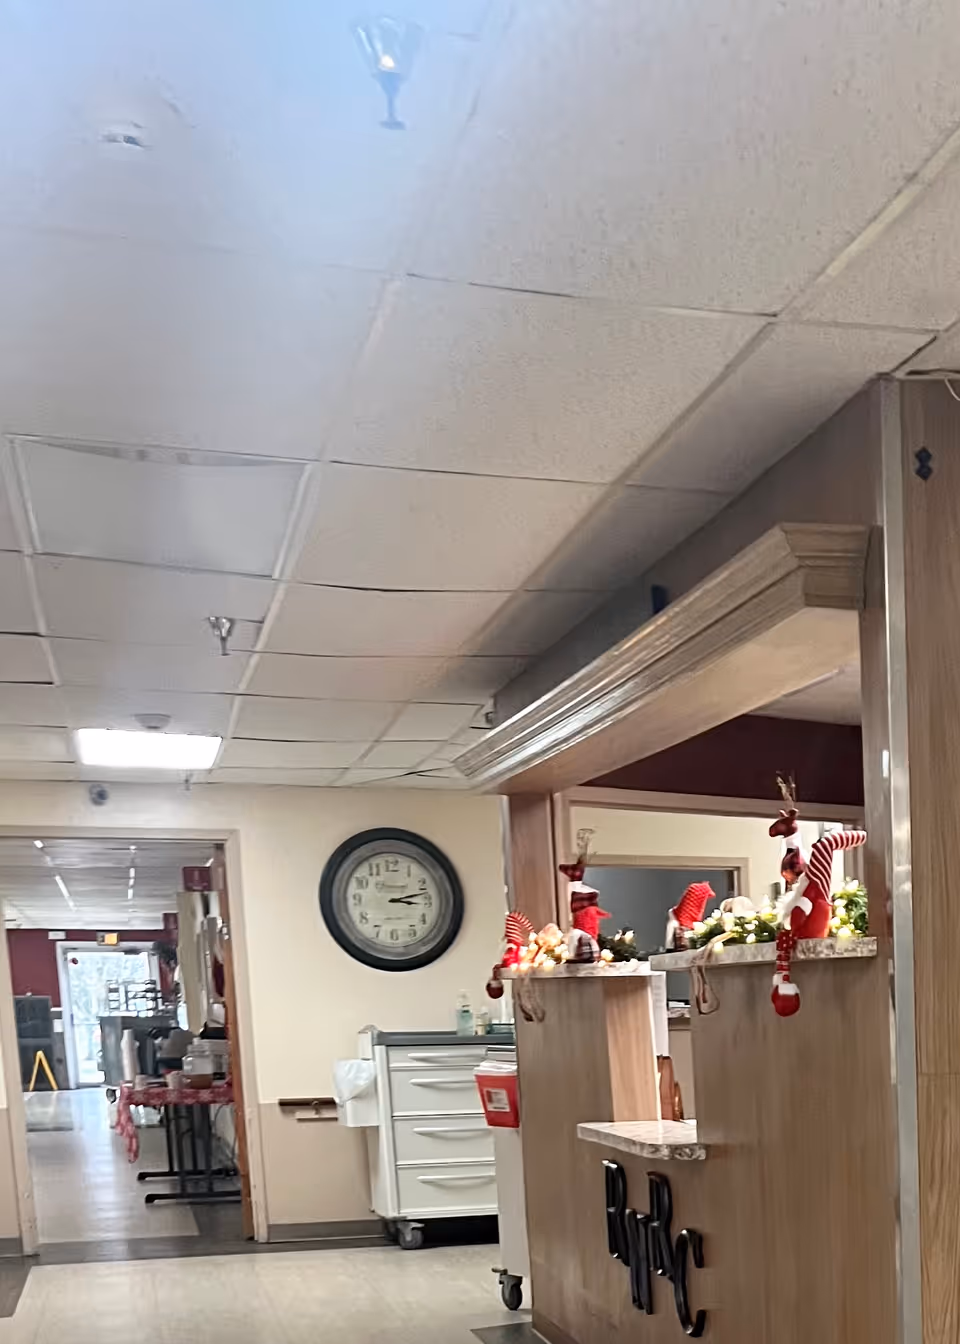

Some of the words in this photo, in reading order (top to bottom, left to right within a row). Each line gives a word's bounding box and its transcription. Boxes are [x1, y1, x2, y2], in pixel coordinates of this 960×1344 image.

[368, 862, 381, 876] 11
[384, 859, 399, 872] 12
[406, 864, 412, 878] 1
[355, 876, 369, 889] 10
[418, 877, 427, 890] 2
[373, 924, 382, 938] 7
